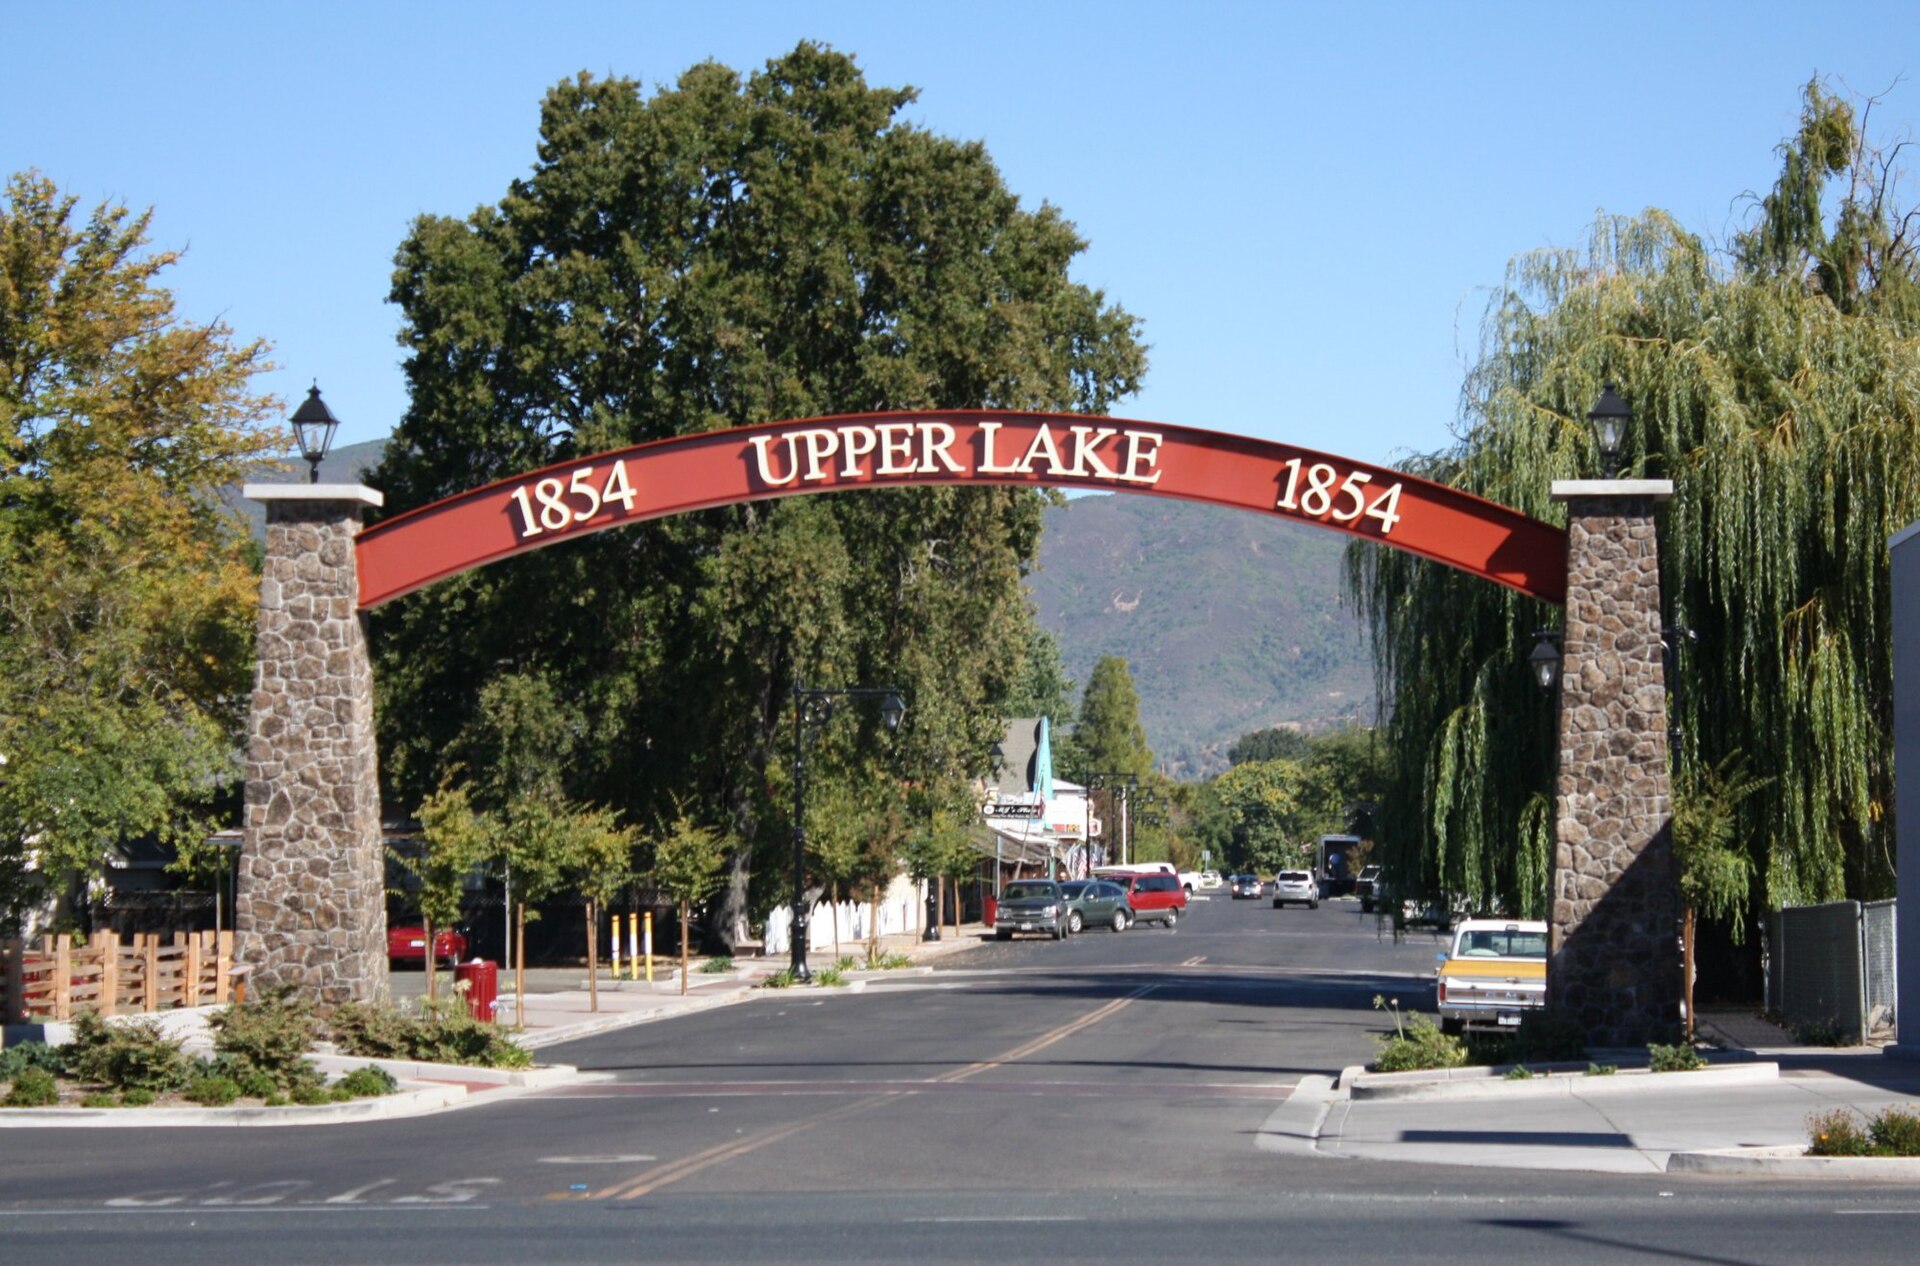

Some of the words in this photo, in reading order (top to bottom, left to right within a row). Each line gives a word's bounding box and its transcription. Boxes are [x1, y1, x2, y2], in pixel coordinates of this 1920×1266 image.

[510, 459, 638, 538] 1854
[748, 422, 966, 485] UPPER
[977, 421, 1163, 484] LAKE
[1277, 457, 1403, 533] 1854
